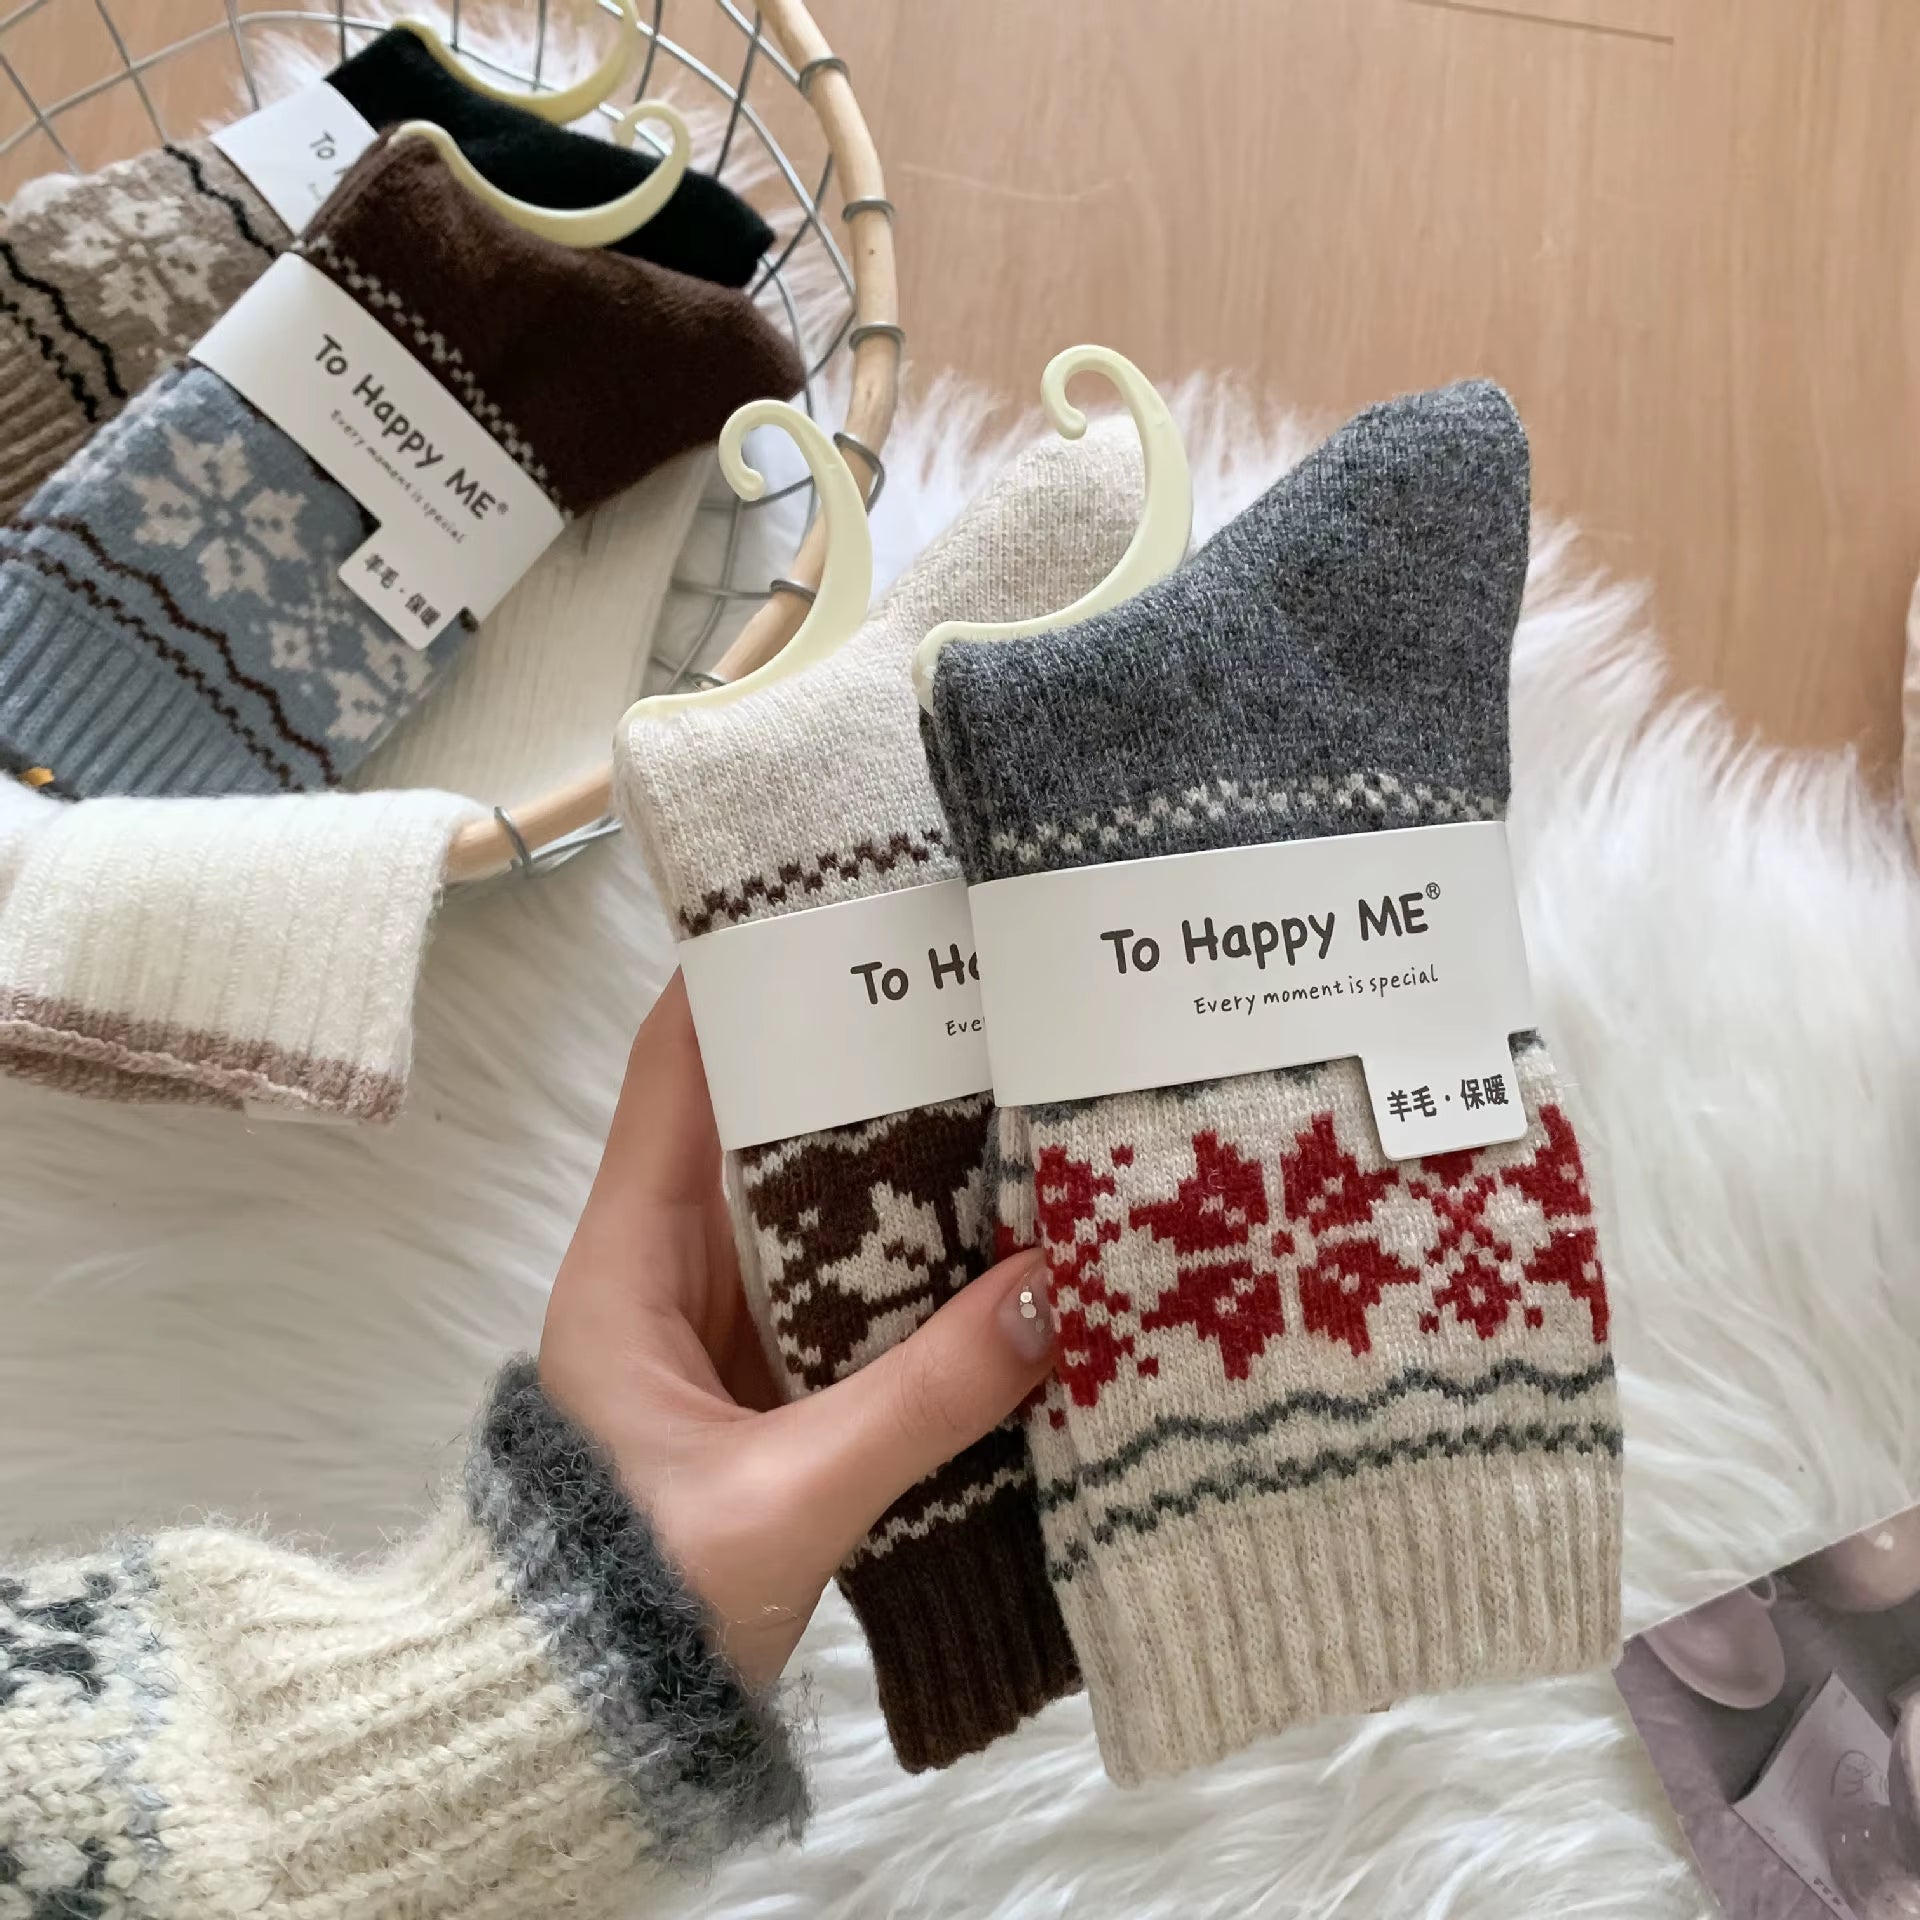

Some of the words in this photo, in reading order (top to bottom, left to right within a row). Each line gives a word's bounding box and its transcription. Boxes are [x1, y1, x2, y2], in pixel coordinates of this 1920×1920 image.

[308, 130, 336, 160] To
[313, 333, 349, 376] To
[352, 373, 445, 469] Happy
[330, 408, 366, 447] Every
[366, 446, 412, 492] moment
[422, 502, 467, 545] special
[1100, 929, 1160, 975] To
[1181, 912, 1336, 970] Happy
[850, 961, 909, 1005] To
[1193, 994, 1257, 1016] Every
[1263, 980, 1344, 1005] moment
[1347, 975, 1364, 995] is
[1369, 963, 1440, 998] special
[945, 1016, 985, 1037] Eve
